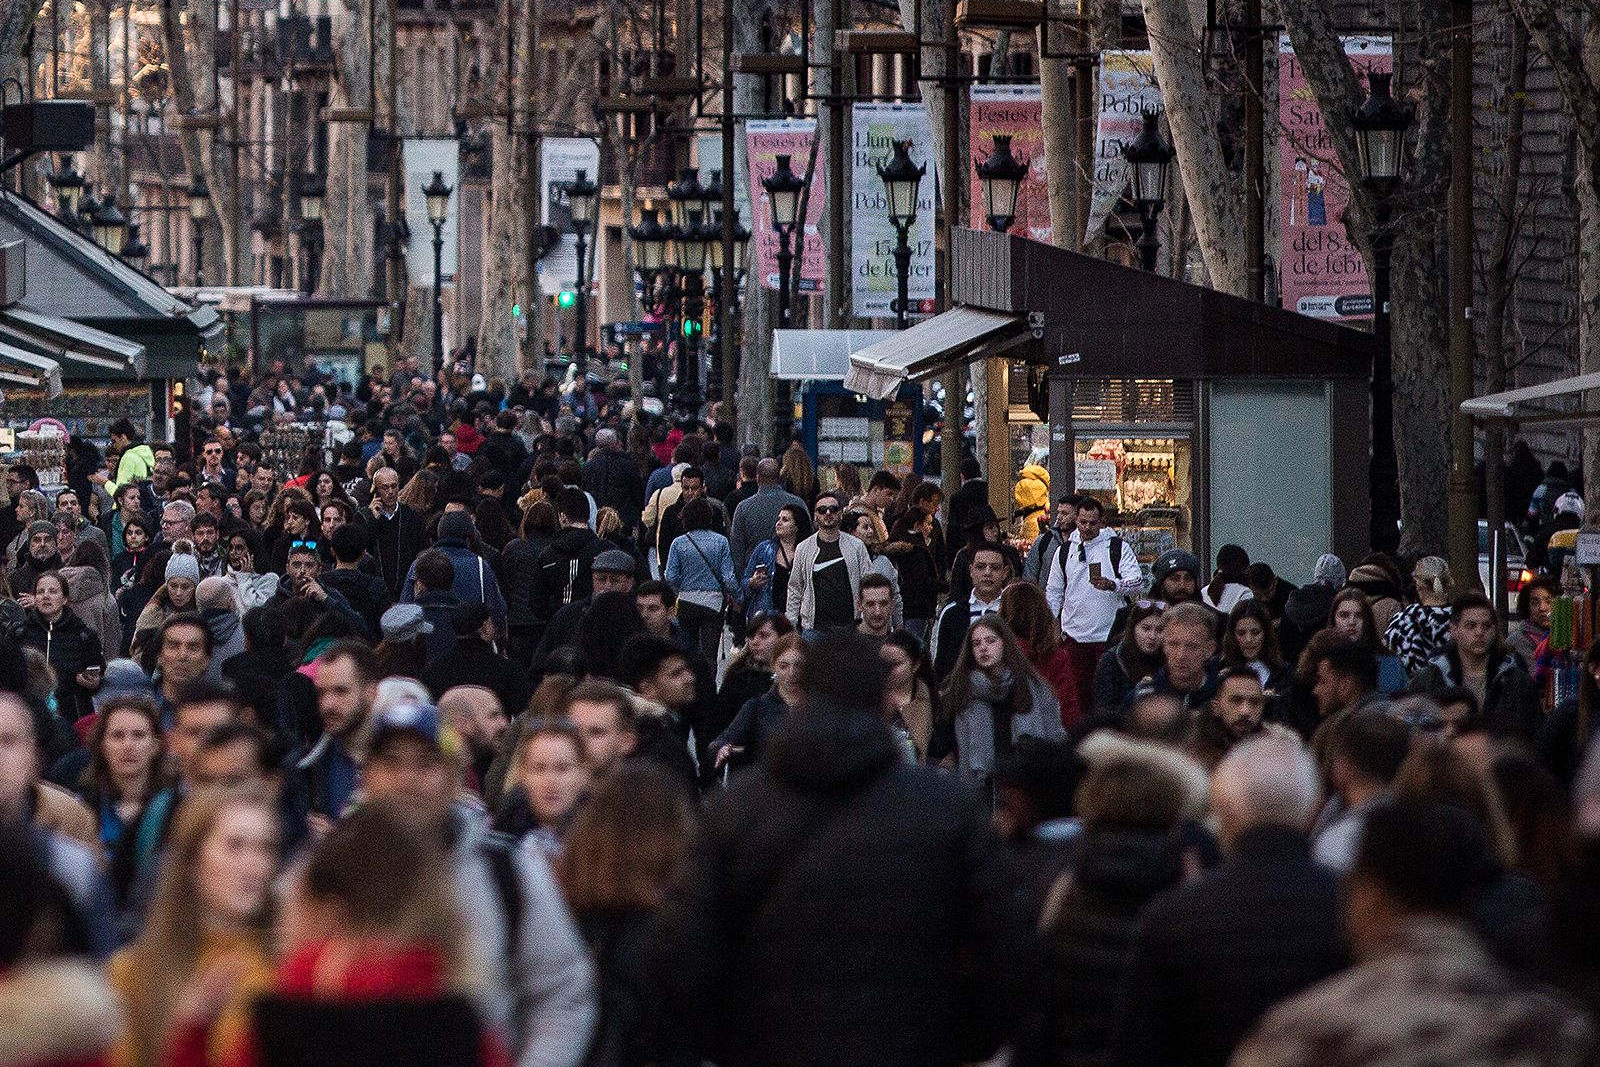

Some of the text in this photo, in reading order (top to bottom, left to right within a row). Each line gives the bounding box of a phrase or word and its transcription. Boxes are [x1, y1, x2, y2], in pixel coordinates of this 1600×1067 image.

[979, 106, 1029, 122] Festes
[1101, 138, 1119, 159] 15
[1097, 163, 1118, 182] de
[876, 240, 891, 255] 15
[1293, 231, 1322, 252] del
[1326, 231, 1340, 252] 8
[860, 259, 933, 277] de ferer
[1293, 254, 1319, 274] de
